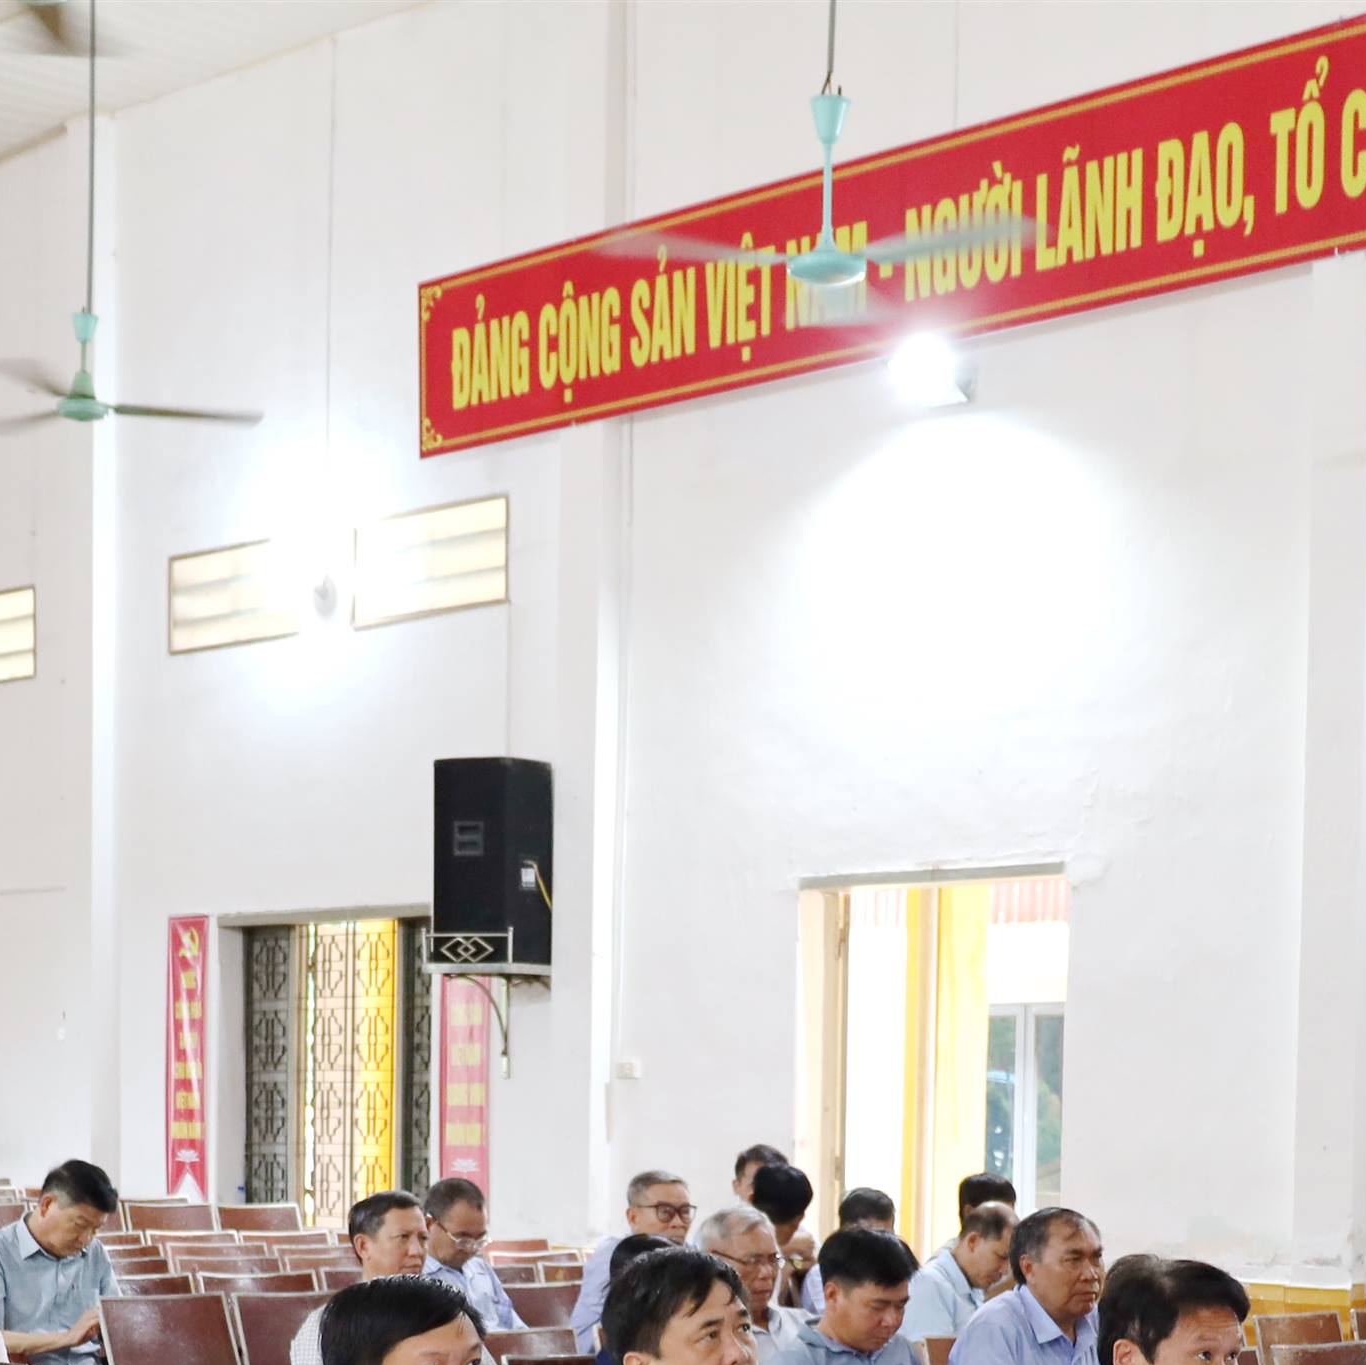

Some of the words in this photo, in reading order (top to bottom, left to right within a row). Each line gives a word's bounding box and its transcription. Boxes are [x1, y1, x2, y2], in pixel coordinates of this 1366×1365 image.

[451, 293, 530, 410] ĐẢNG
[537, 281, 622, 404] CỘNG
[629, 245, 696, 368] SẢN
[704, 231, 777, 362] VIỆT
[904, 159, 1023, 303] NGƯỜI
[1035, 143, 1143, 272] LÃNH
[1155, 122, 1256, 258] ĐẠO,
[1270, 54, 1329, 216] TỔ
